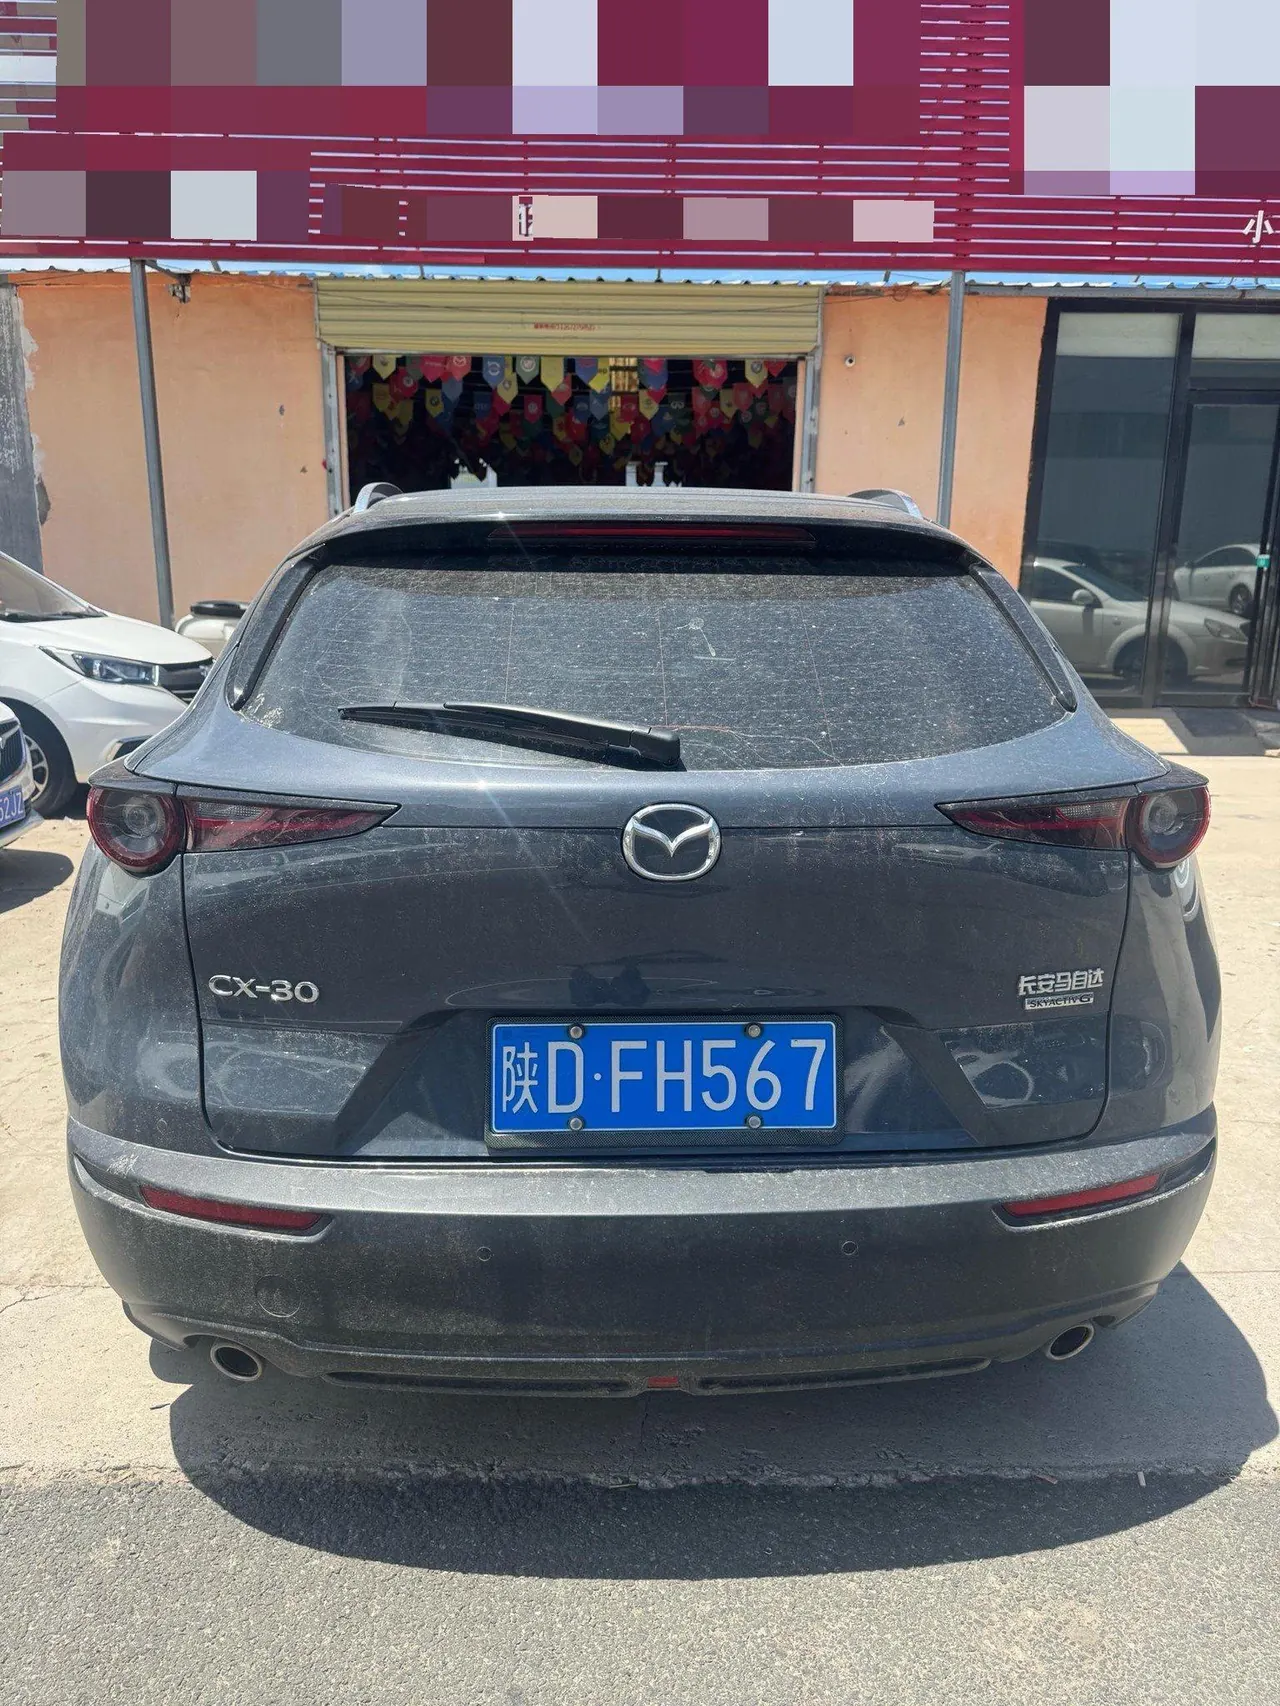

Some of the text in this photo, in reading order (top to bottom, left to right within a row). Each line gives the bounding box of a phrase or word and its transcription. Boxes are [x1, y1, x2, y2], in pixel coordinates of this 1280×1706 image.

[1242, 210, 1275, 243] 小
[208, 974, 320, 1003] CX-30
[1018, 967, 1105, 996] 长安马自达
